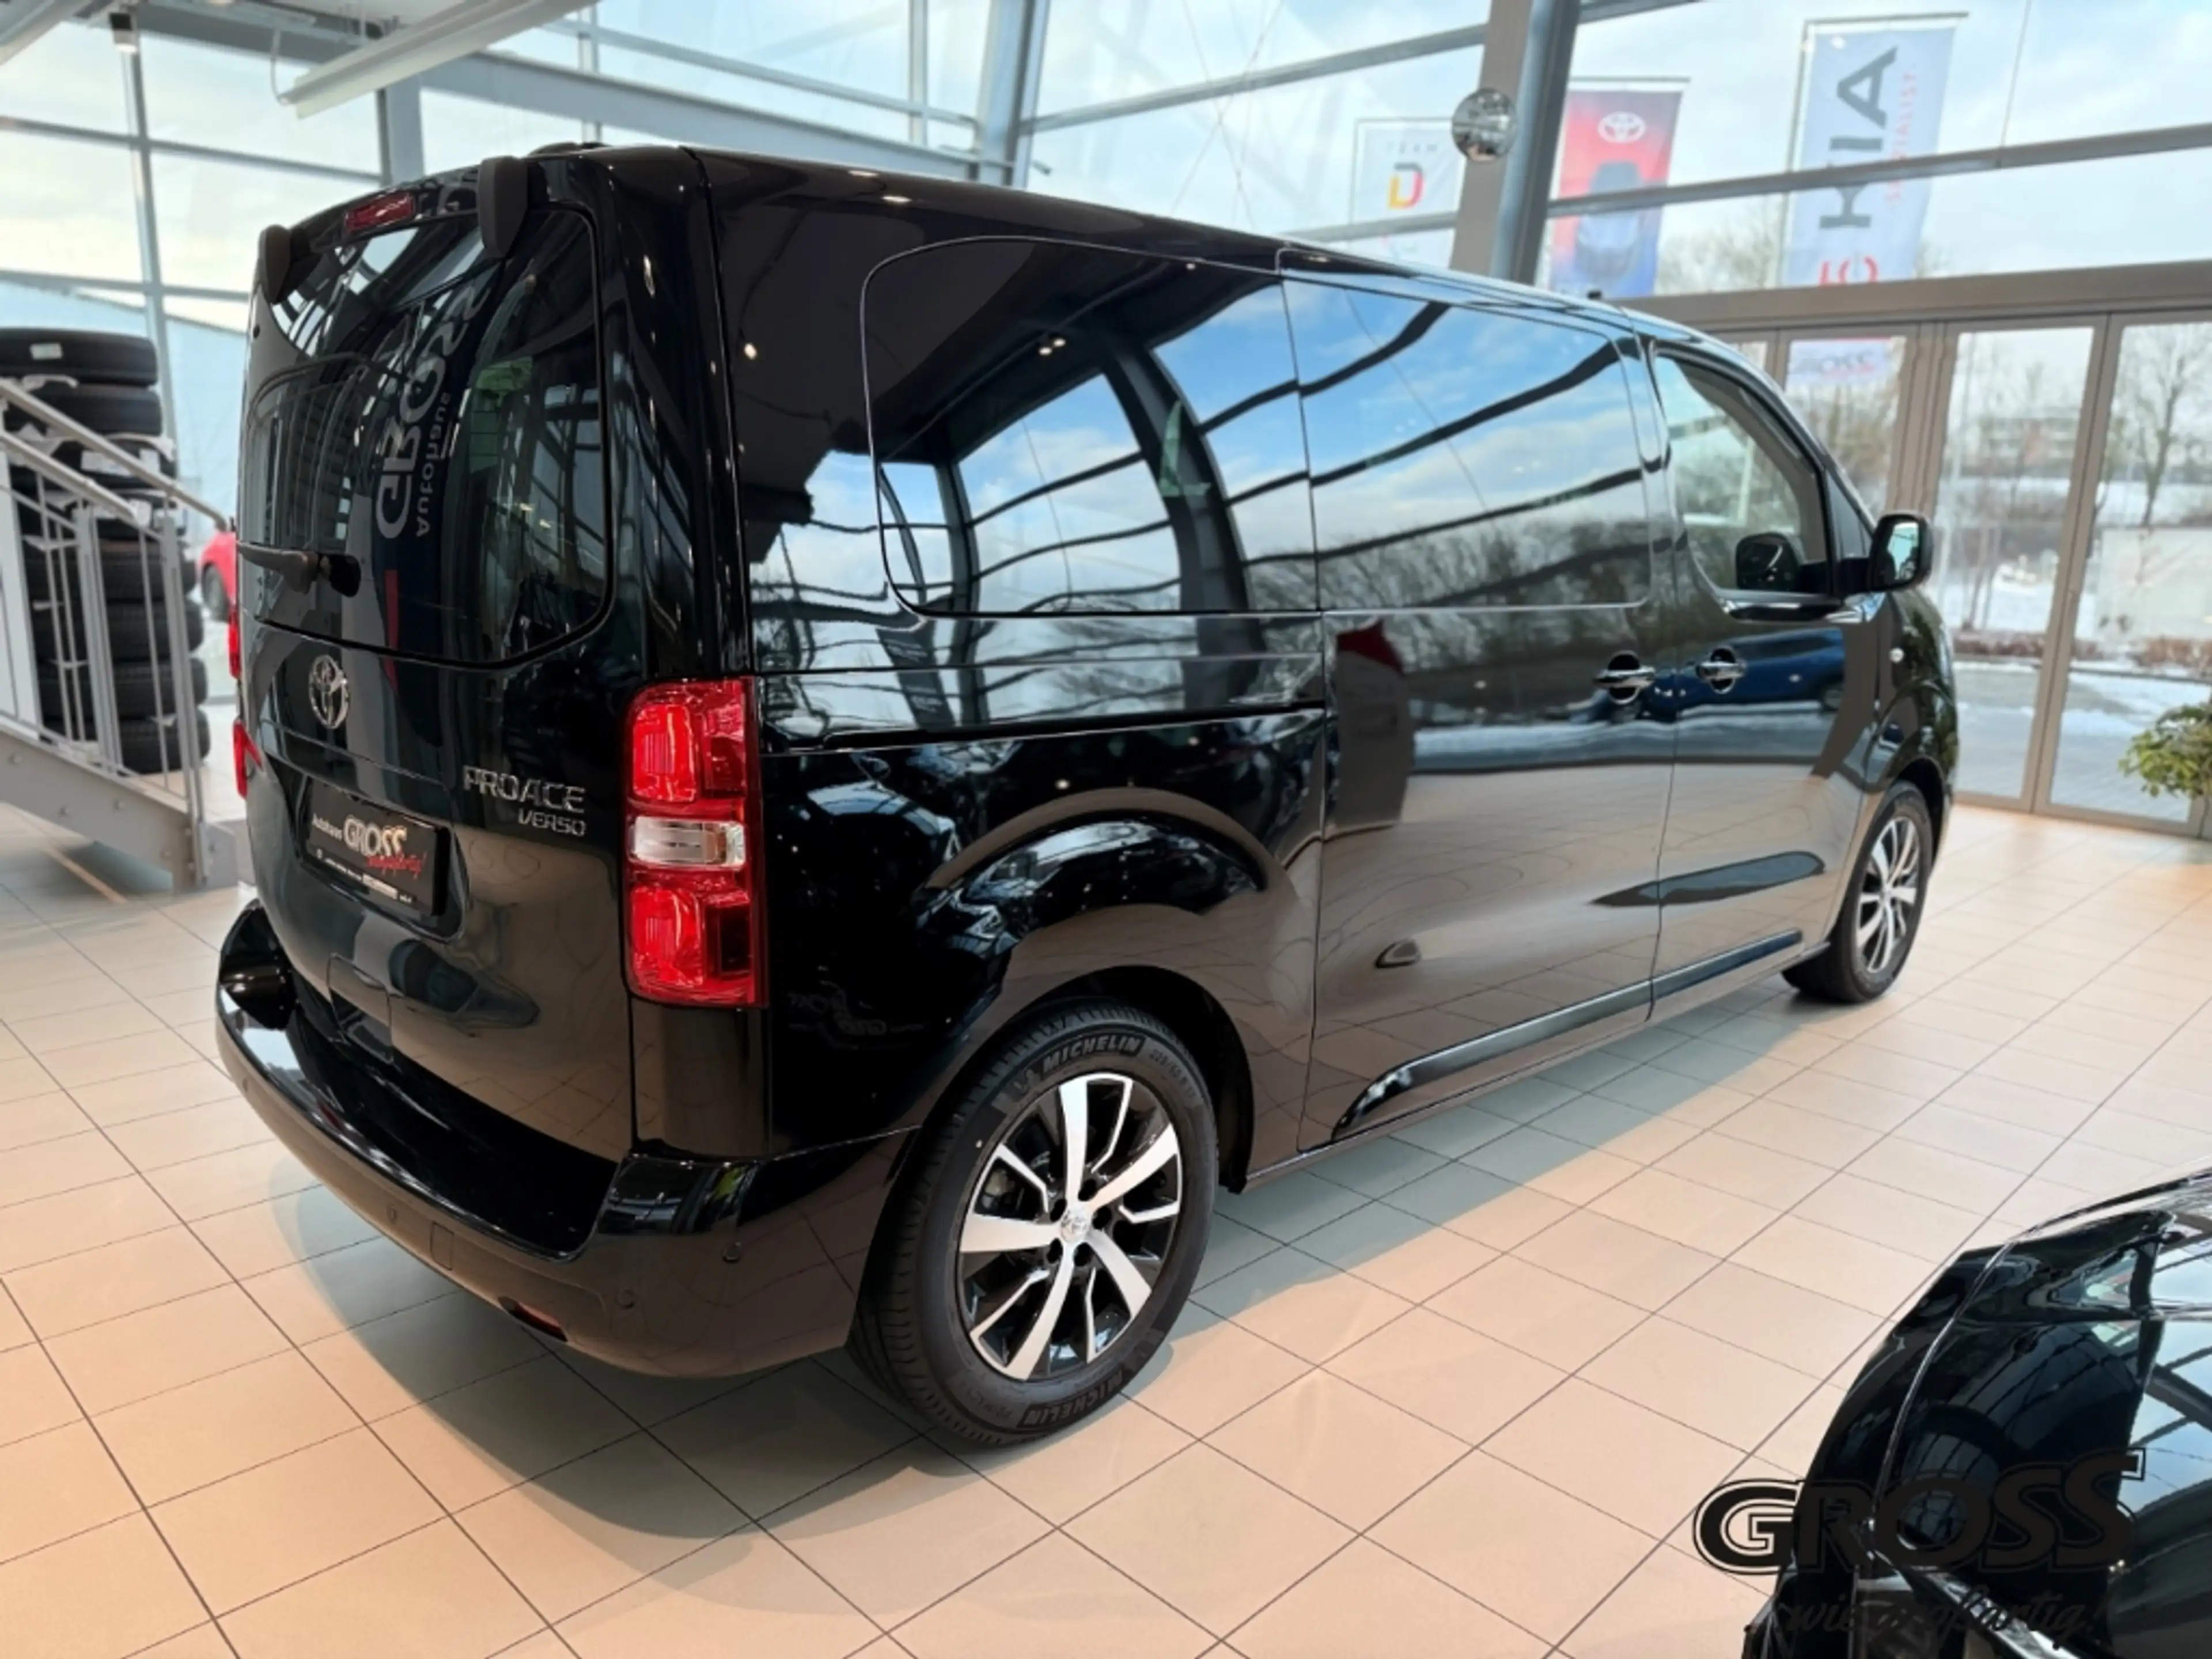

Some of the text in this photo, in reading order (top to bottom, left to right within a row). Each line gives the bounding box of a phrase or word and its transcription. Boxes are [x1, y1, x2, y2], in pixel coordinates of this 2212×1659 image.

[1819, 45, 1898, 230] KIA
[463, 764, 586, 814] PROACE
[518, 807, 586, 837] VERSO
[1042, 1035, 1143, 1074] MICHELIN
